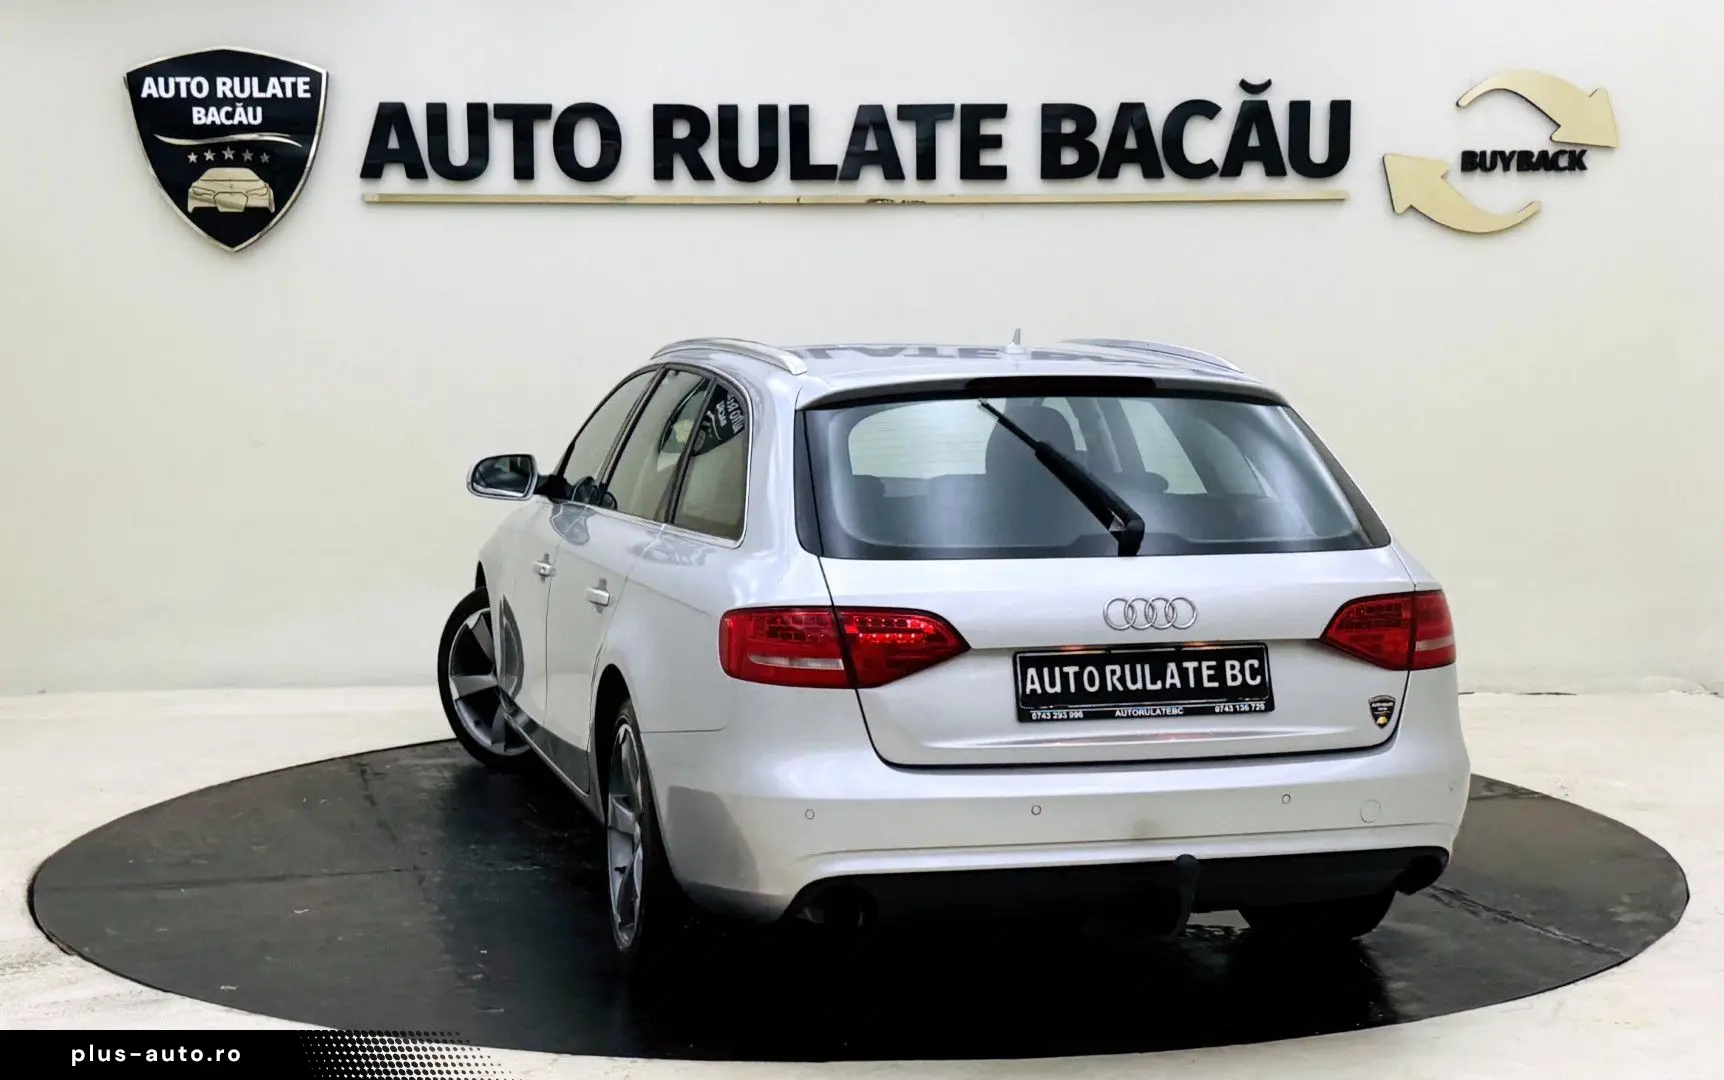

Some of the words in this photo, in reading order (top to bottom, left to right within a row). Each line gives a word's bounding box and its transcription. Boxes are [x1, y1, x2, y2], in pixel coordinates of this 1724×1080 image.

[141, 76, 210, 99] AUTO
[216, 76, 311, 99] RULATE
[192, 103, 263, 125] BACĂU
[360, 101, 622, 182] AUTO
[652, 103, 1008, 182] RULATE
[1040, 78, 1352, 180] BACĂU
[1461, 149, 1588, 172] BUYBACK
[1025, 665, 1101, 695] AUTO
[1105, 660, 1219, 692] RULATE
[1224, 659, 1262, 687] BC
[1114, 706, 1184, 717] AUTORULATEBC
